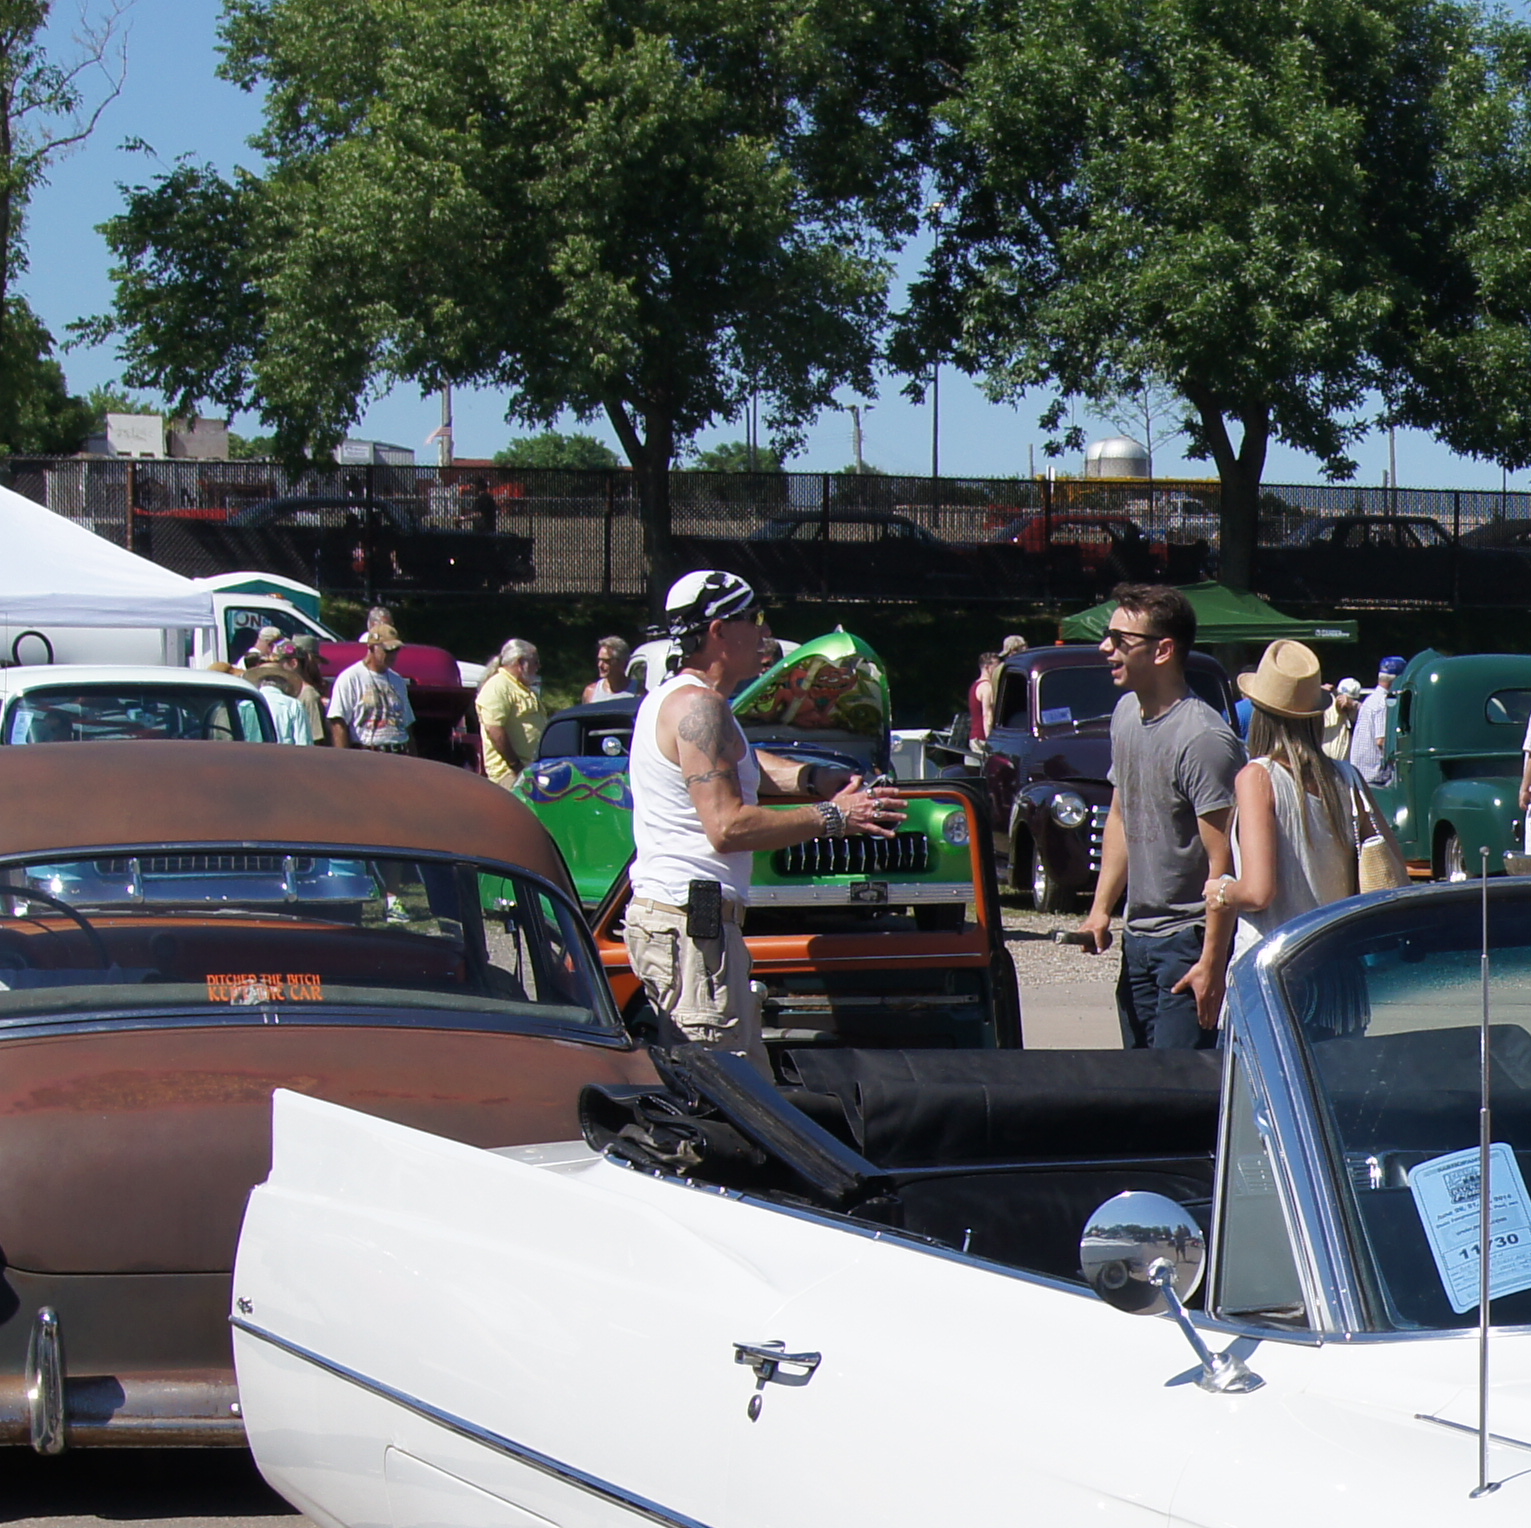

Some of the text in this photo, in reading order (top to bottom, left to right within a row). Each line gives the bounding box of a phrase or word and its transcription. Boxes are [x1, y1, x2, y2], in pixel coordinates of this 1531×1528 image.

[206, 974, 321, 985] DITCHED THE BITCH
[290, 985, 324, 1001] CAR
